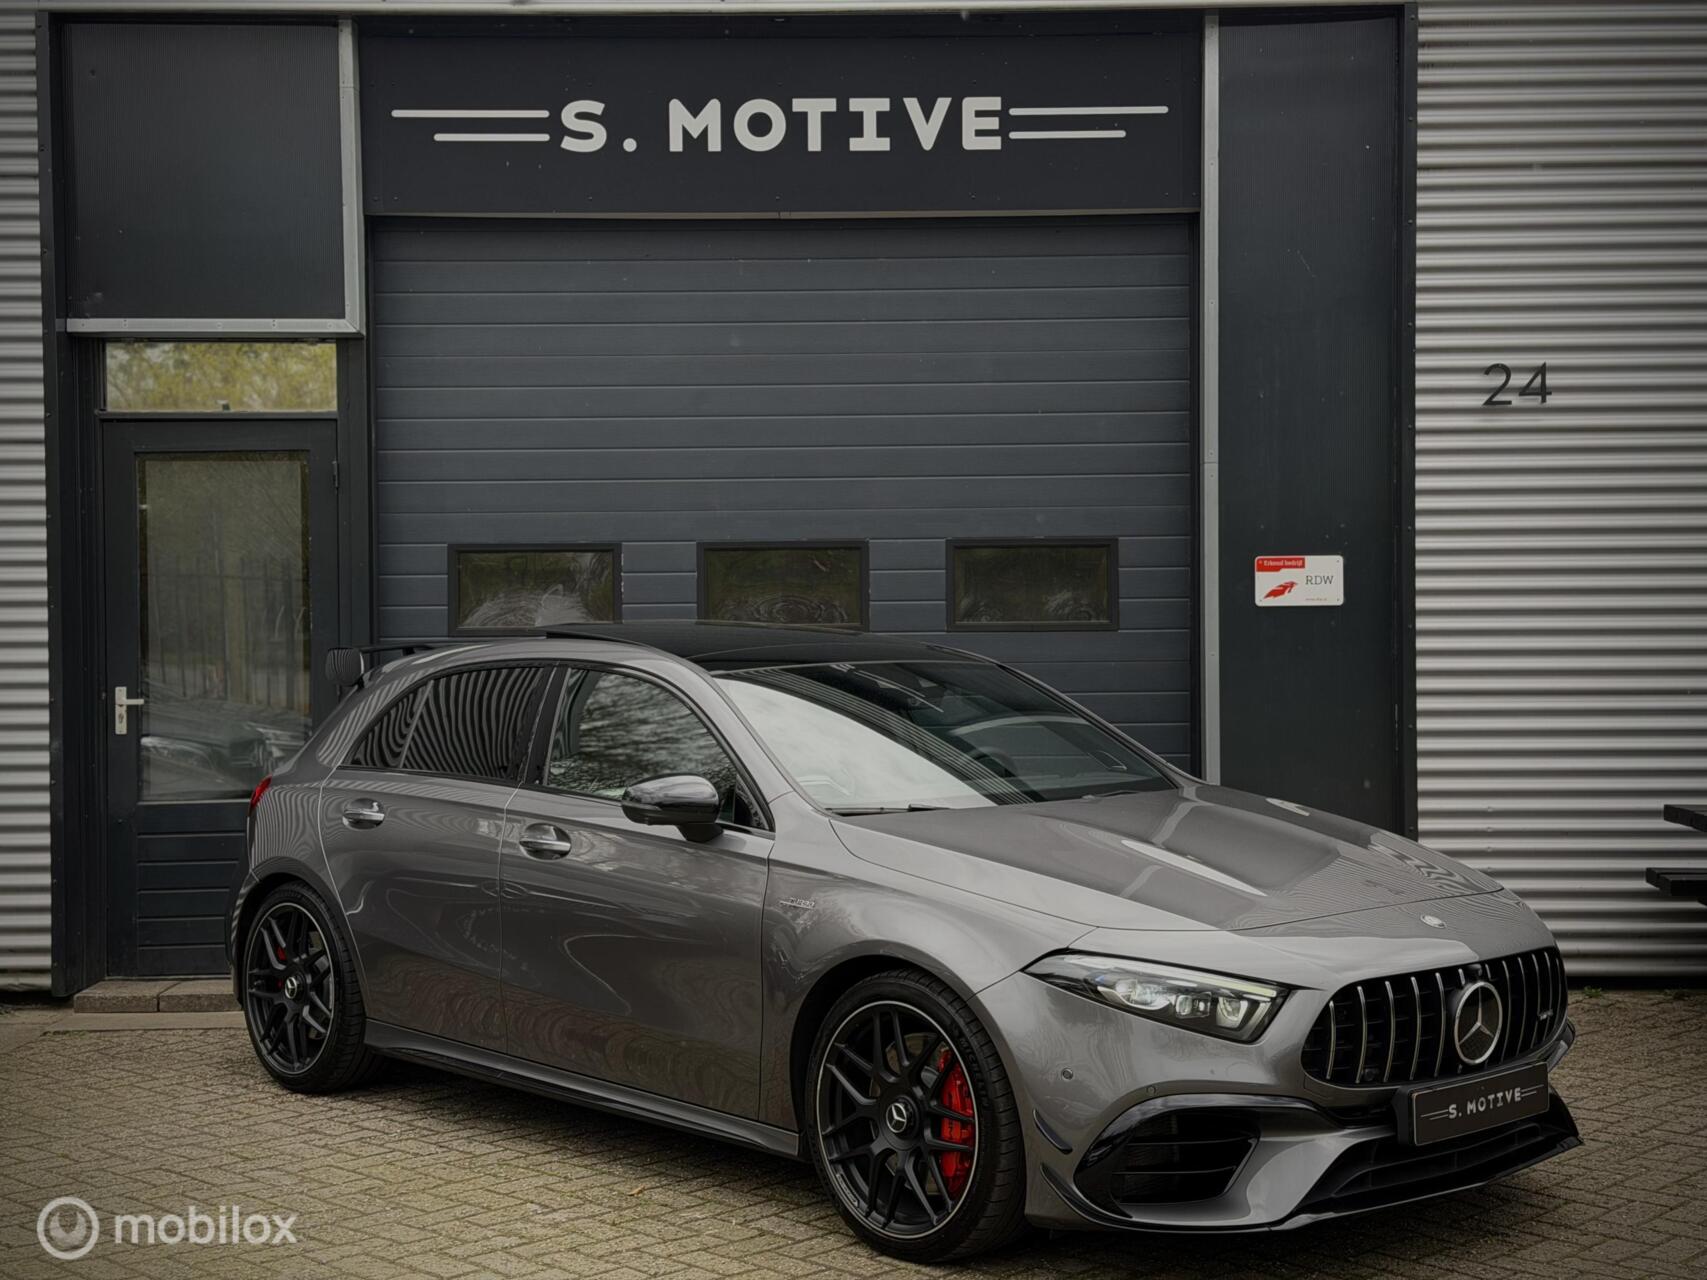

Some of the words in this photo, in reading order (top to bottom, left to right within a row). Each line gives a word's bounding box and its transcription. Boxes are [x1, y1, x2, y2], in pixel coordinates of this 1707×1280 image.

[560, 99, 637, 153] S.
[668, 96, 1003, 152] MOTIVE
[1482, 361, 1552, 406] 24
[1305, 575, 1334, 585] RDW
[1448, 1103, 1462, 1119] S.
[1466, 1087, 1521, 1115] MOTIVE
